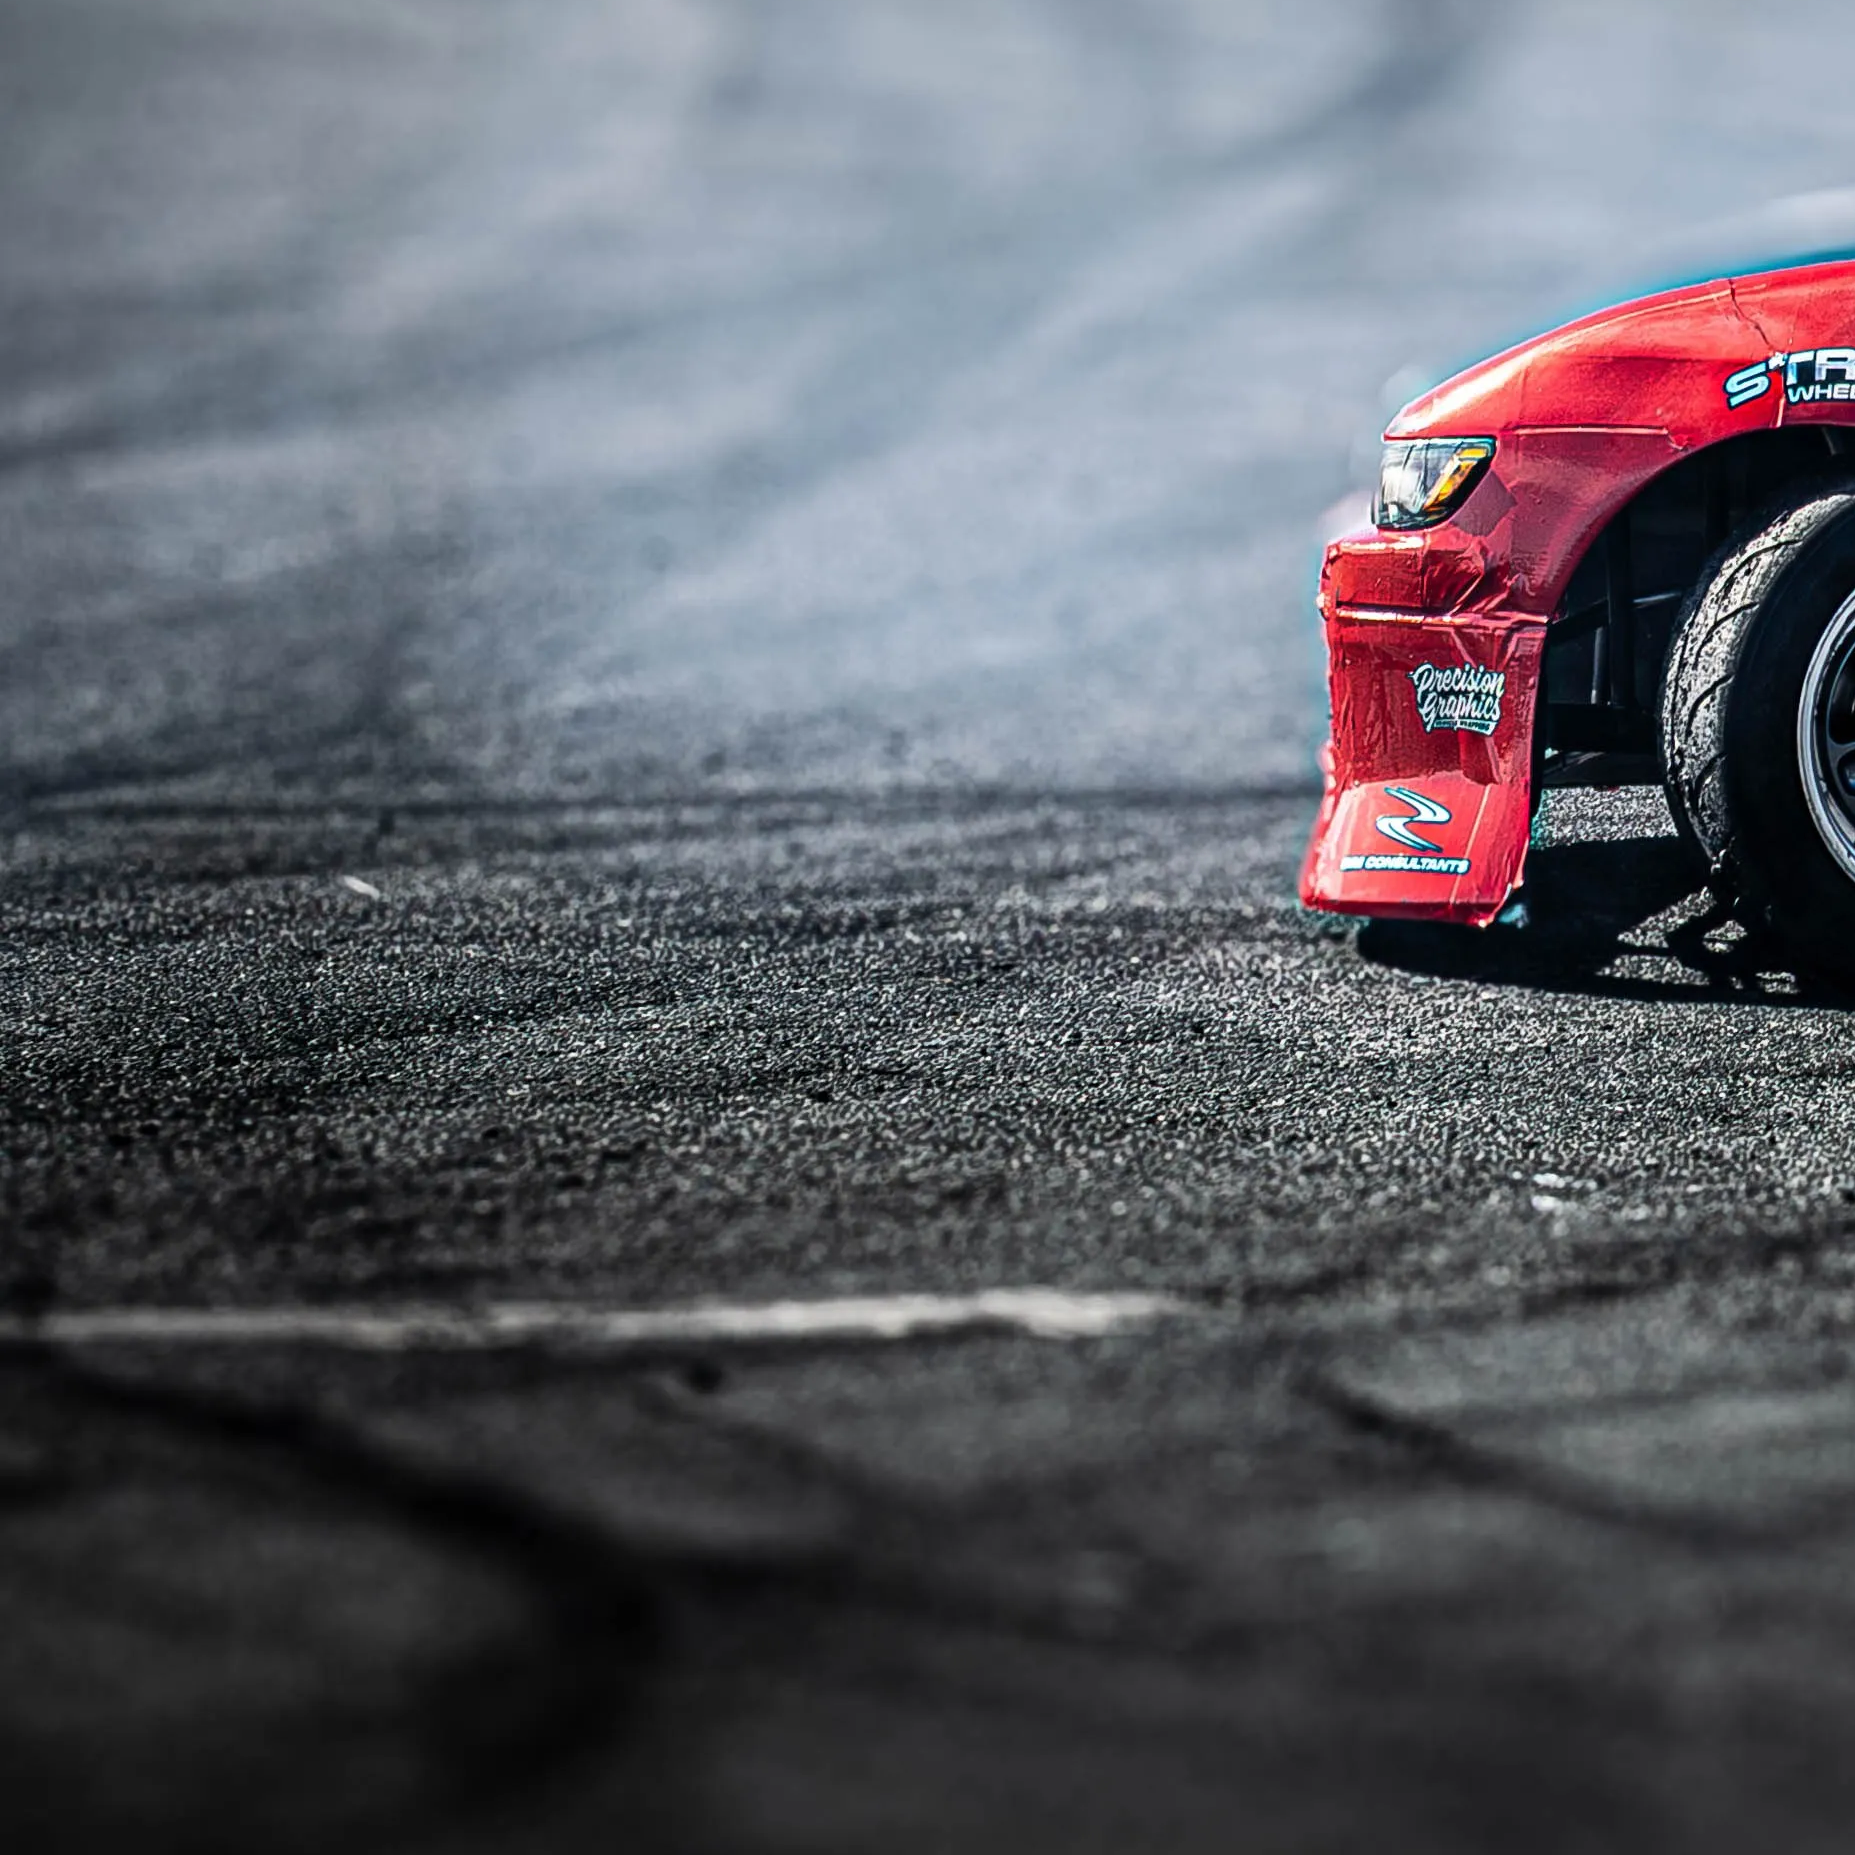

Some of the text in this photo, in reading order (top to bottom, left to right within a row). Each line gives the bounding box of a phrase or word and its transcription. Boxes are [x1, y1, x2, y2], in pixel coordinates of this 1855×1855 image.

[1408, 663, 1505, 706] Precision
[1418, 693, 1500, 732] Graphics
[1365, 855, 1470, 874] CONSULTANTS
